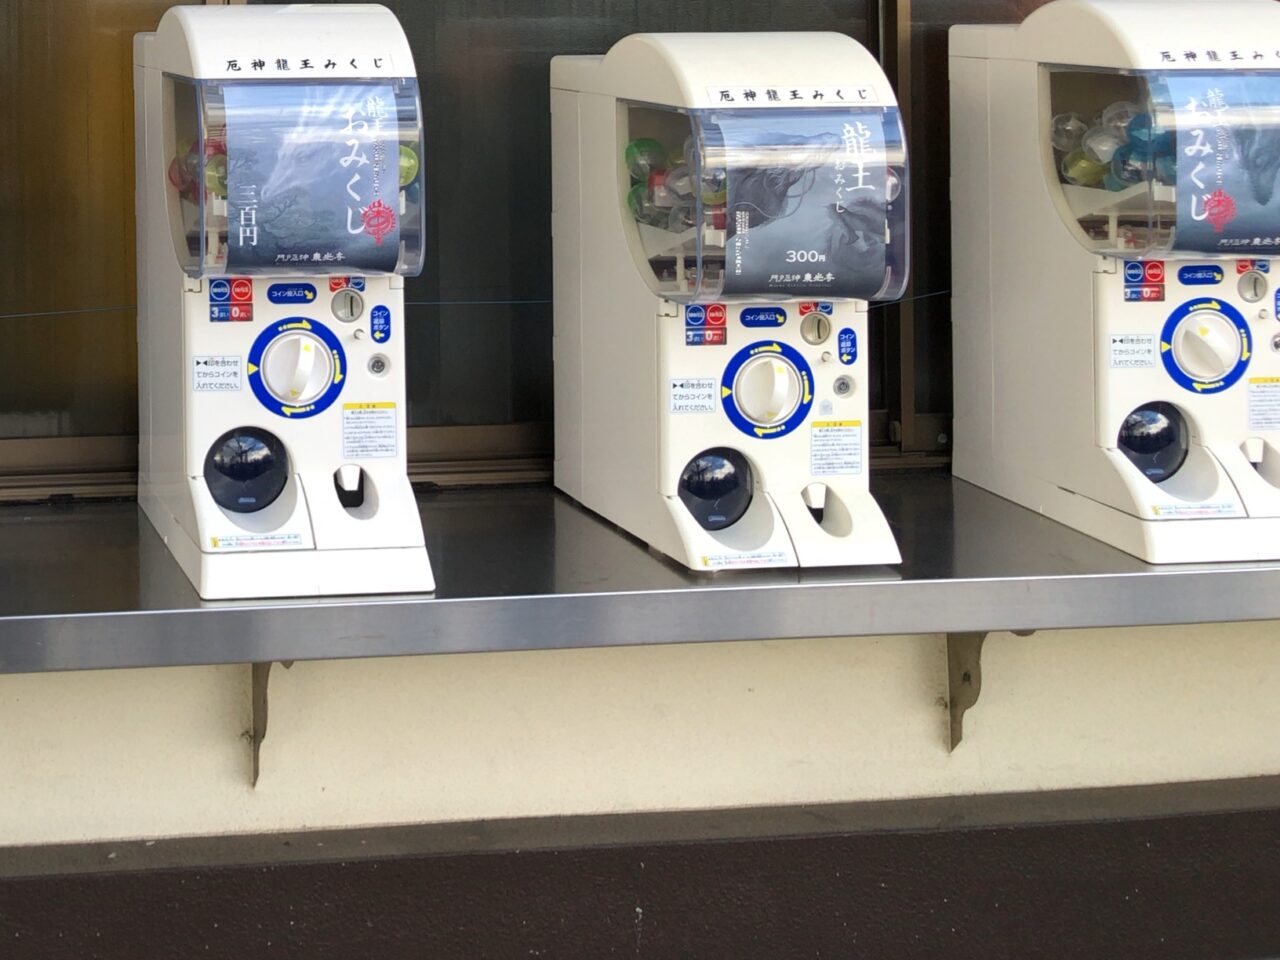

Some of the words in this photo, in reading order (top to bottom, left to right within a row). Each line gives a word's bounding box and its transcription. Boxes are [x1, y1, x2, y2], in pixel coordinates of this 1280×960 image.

[339, 105, 370, 235] おみくじ
[785, 250, 826, 263] 300円
